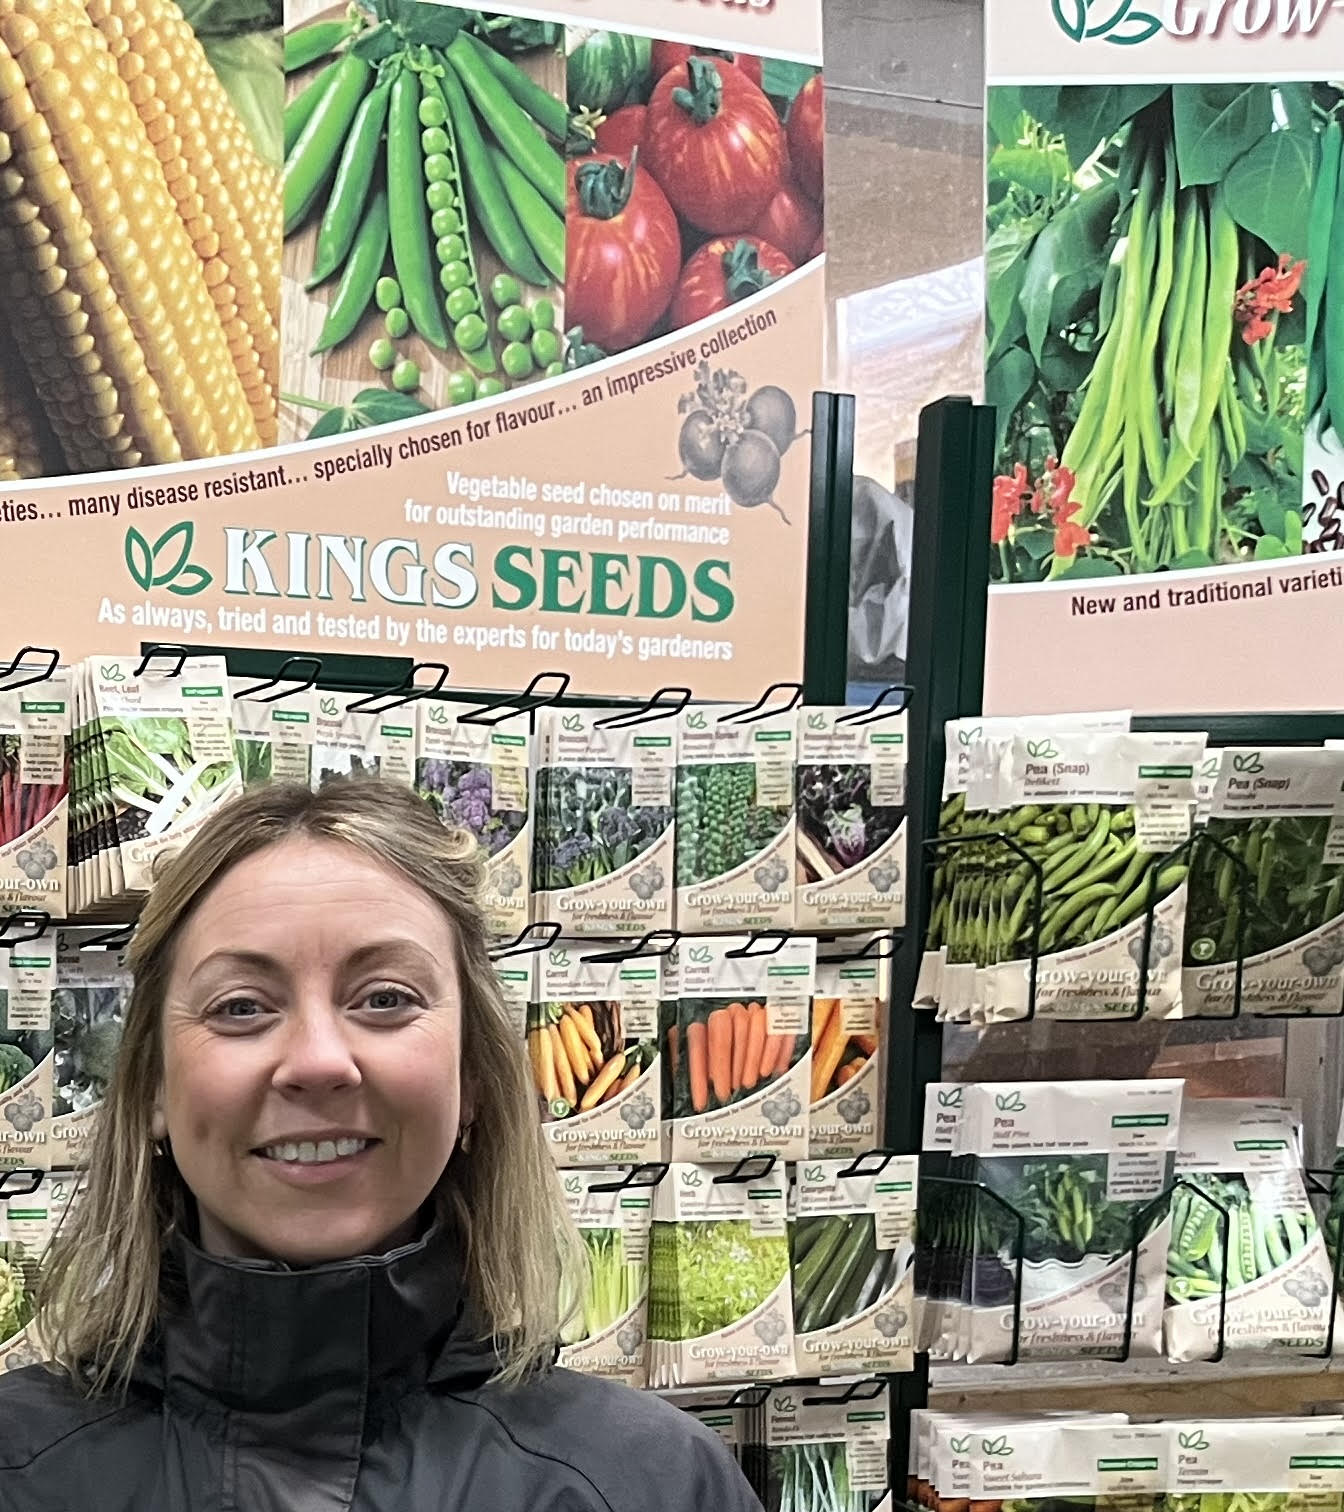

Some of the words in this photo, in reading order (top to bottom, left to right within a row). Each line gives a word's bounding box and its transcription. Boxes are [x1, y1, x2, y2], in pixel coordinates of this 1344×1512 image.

[69, 492, 121, 518] many
[127, 483, 199, 511] disease
[314, 445, 393, 481] specially
[398, 430, 463, 460] chosen
[466, 419, 491, 443] for
[582, 387, 603, 408] an
[607, 351, 697, 399] impressive
[700, 307, 778, 361] collection
[446, 472, 537, 502] Vegetable
[542, 483, 585, 506] seed
[590, 486, 654, 511] chosen
[657, 495, 679, 512] on
[683, 491, 731, 515] merit
[405, 498, 431, 523] for
[436, 503, 545, 536] outstanding
[550, 514, 613, 541] garden
[617, 517, 730, 545] performance
[223, 526, 479, 609] KINGS
[492, 545, 735, 622] SEEDS
[1072, 597, 1116, 616] New
[1123, 590, 1160, 612] and
[1168, 577, 1272, 606] traditional
[98, 598, 127, 624] As
[131, 603, 213, 636] always,
[219, 607, 266, 633] tried
[272, 611, 311, 635] and
[316, 613, 380, 640] tested
[386, 618, 410, 645] by
[416, 619, 448, 644] the
[453, 624, 525, 651] experts
[531, 625, 560, 650] for
[638, 633, 733, 661] gardeners
[1025, 763, 1047, 774] Pea
[1053, 763, 1090, 777] (Snap)
